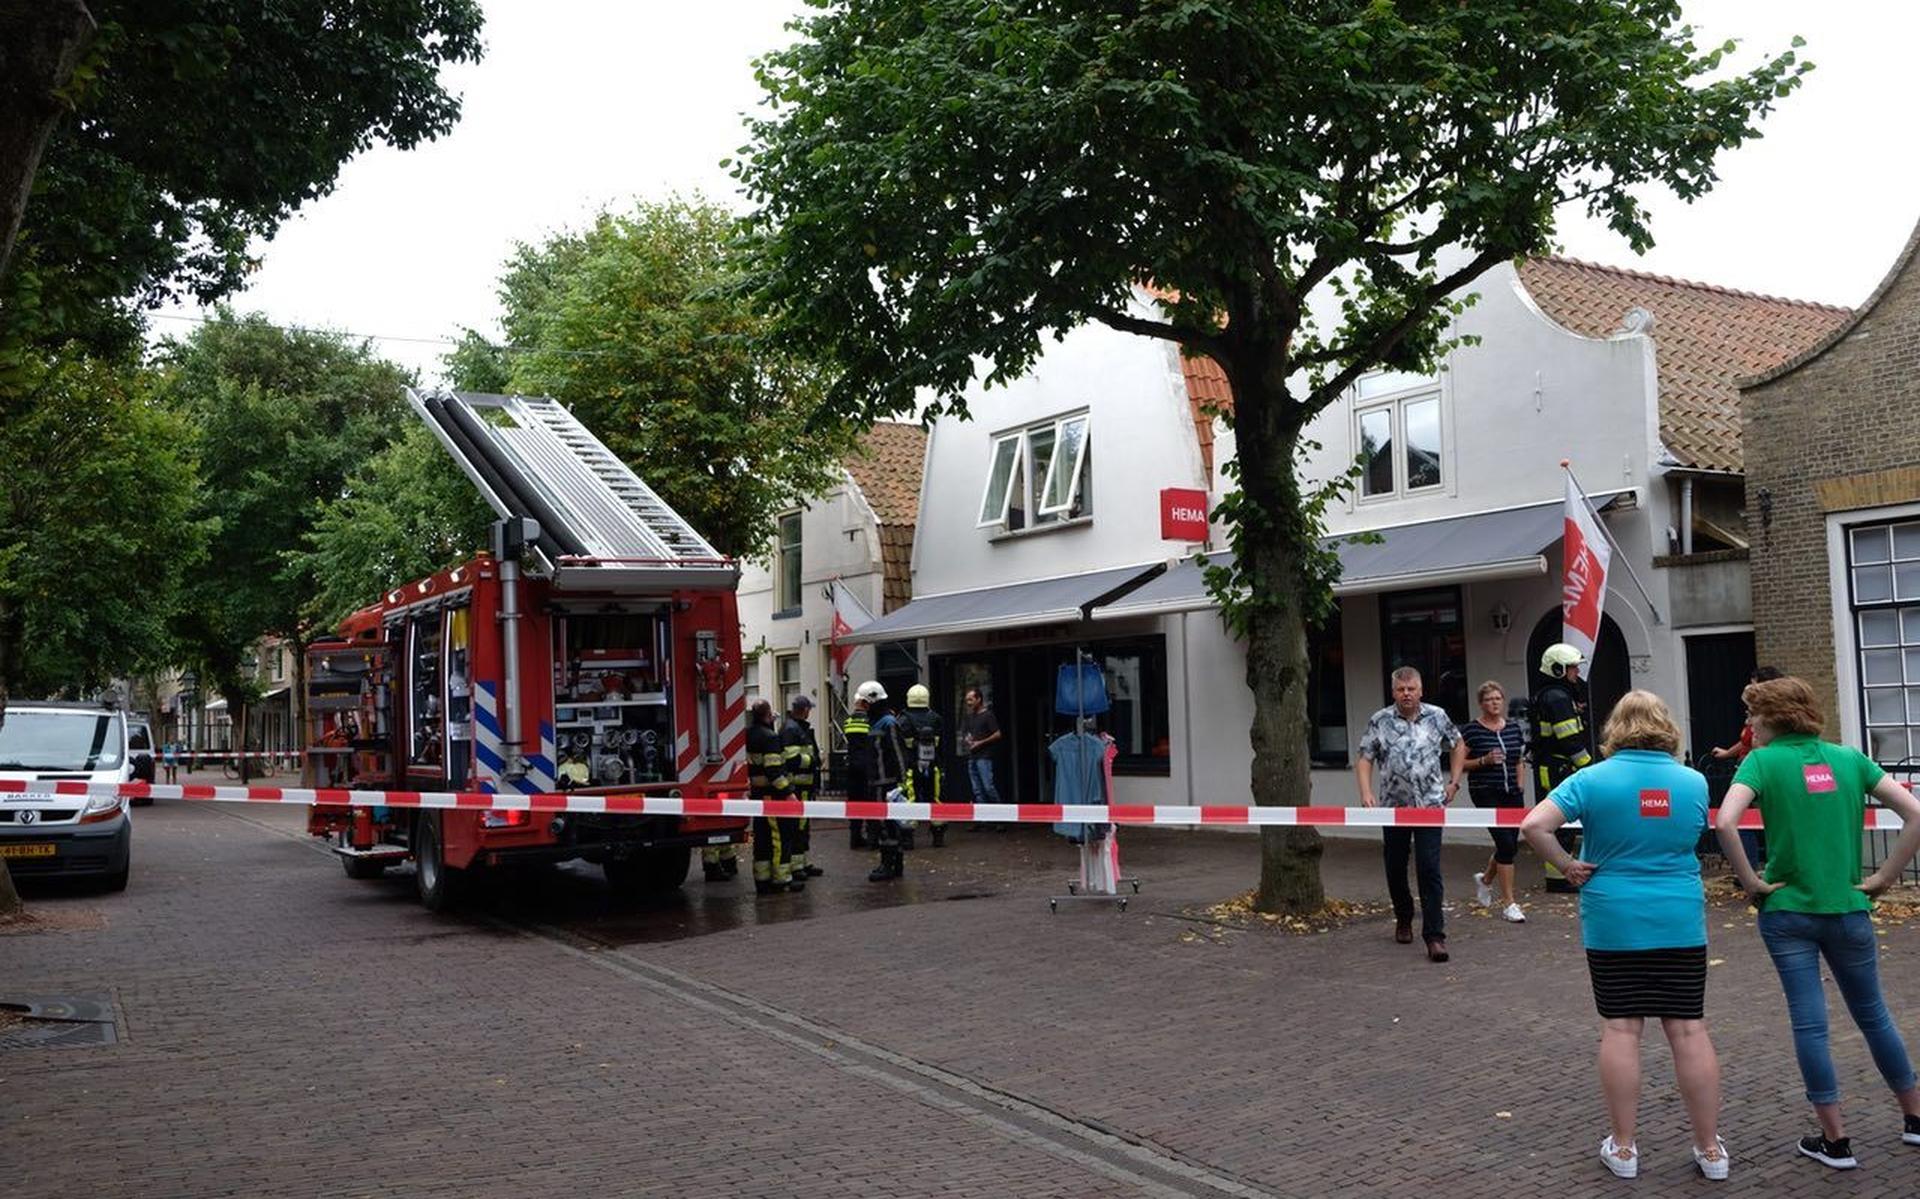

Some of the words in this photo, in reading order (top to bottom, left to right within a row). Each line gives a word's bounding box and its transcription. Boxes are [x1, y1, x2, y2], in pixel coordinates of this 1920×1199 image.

[1172, 507, 1205, 522] HEMA
[1806, 773, 1834, 783] HEMA
[1641, 799, 1669, 808] HEMA
